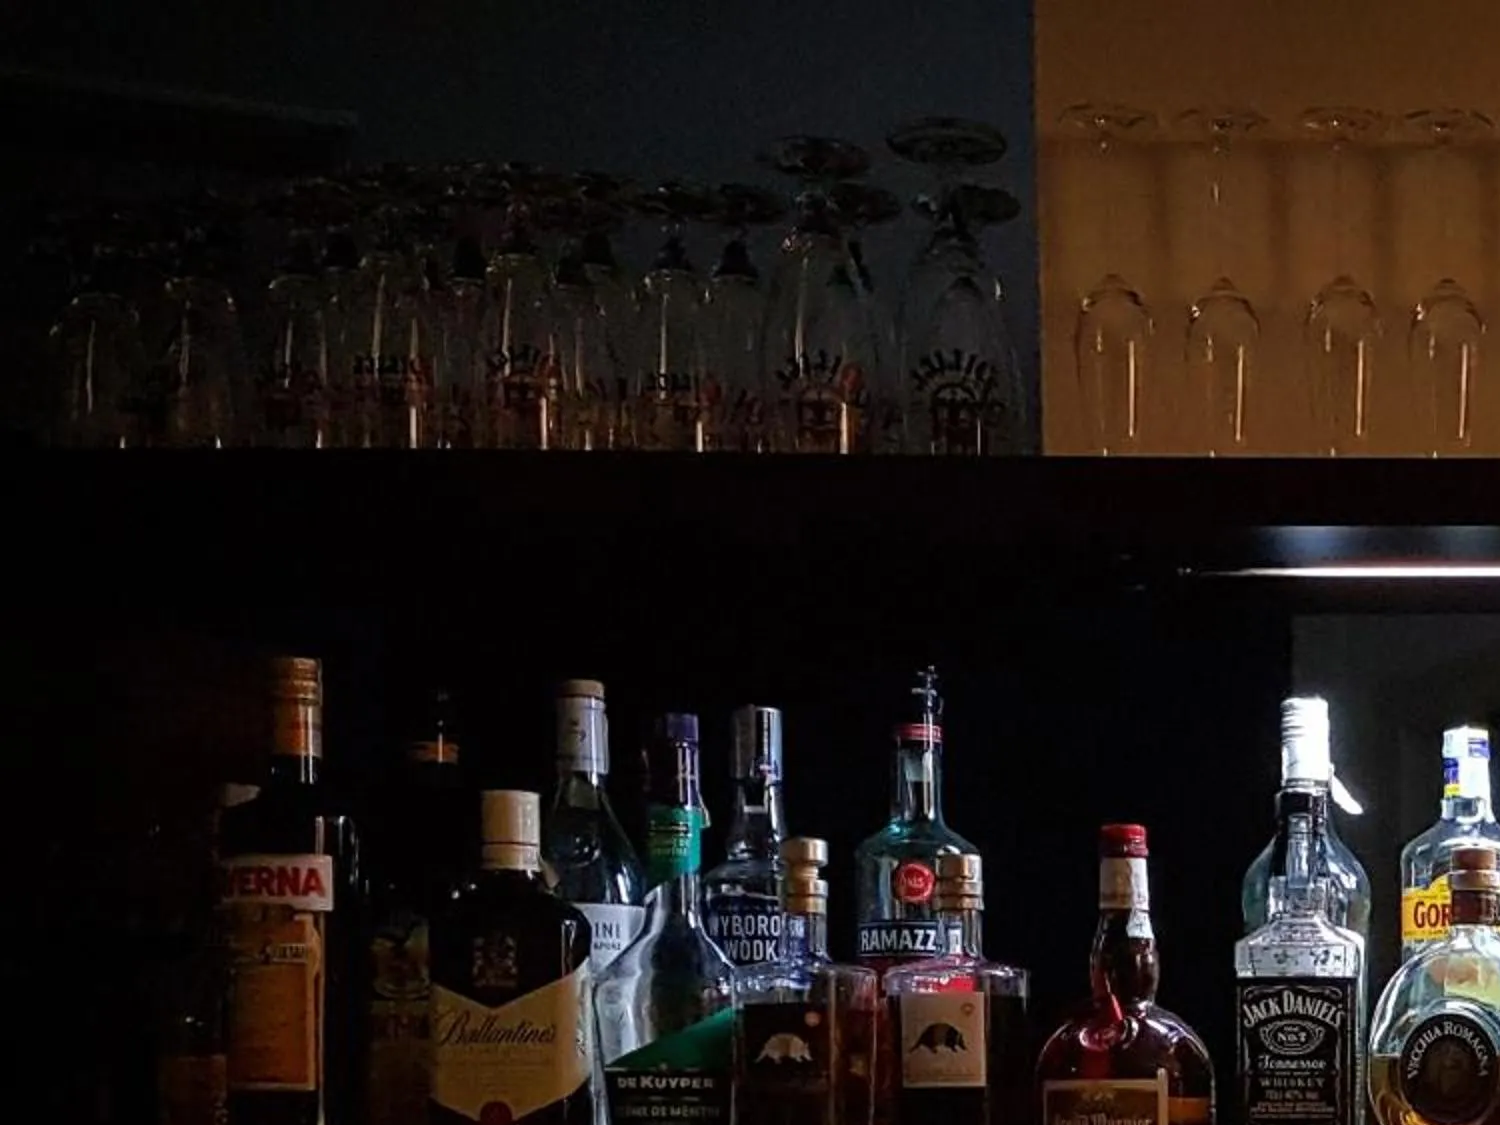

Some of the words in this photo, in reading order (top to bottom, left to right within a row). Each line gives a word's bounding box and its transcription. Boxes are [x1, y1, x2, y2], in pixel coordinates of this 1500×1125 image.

[1243, 999, 1281, 1029] JACK
[1283, 989, 1347, 1029] DANIEL'S
[1443, 1020, 1489, 1077] ROMAGNA
[640, 1074, 714, 1090] KUYPER
